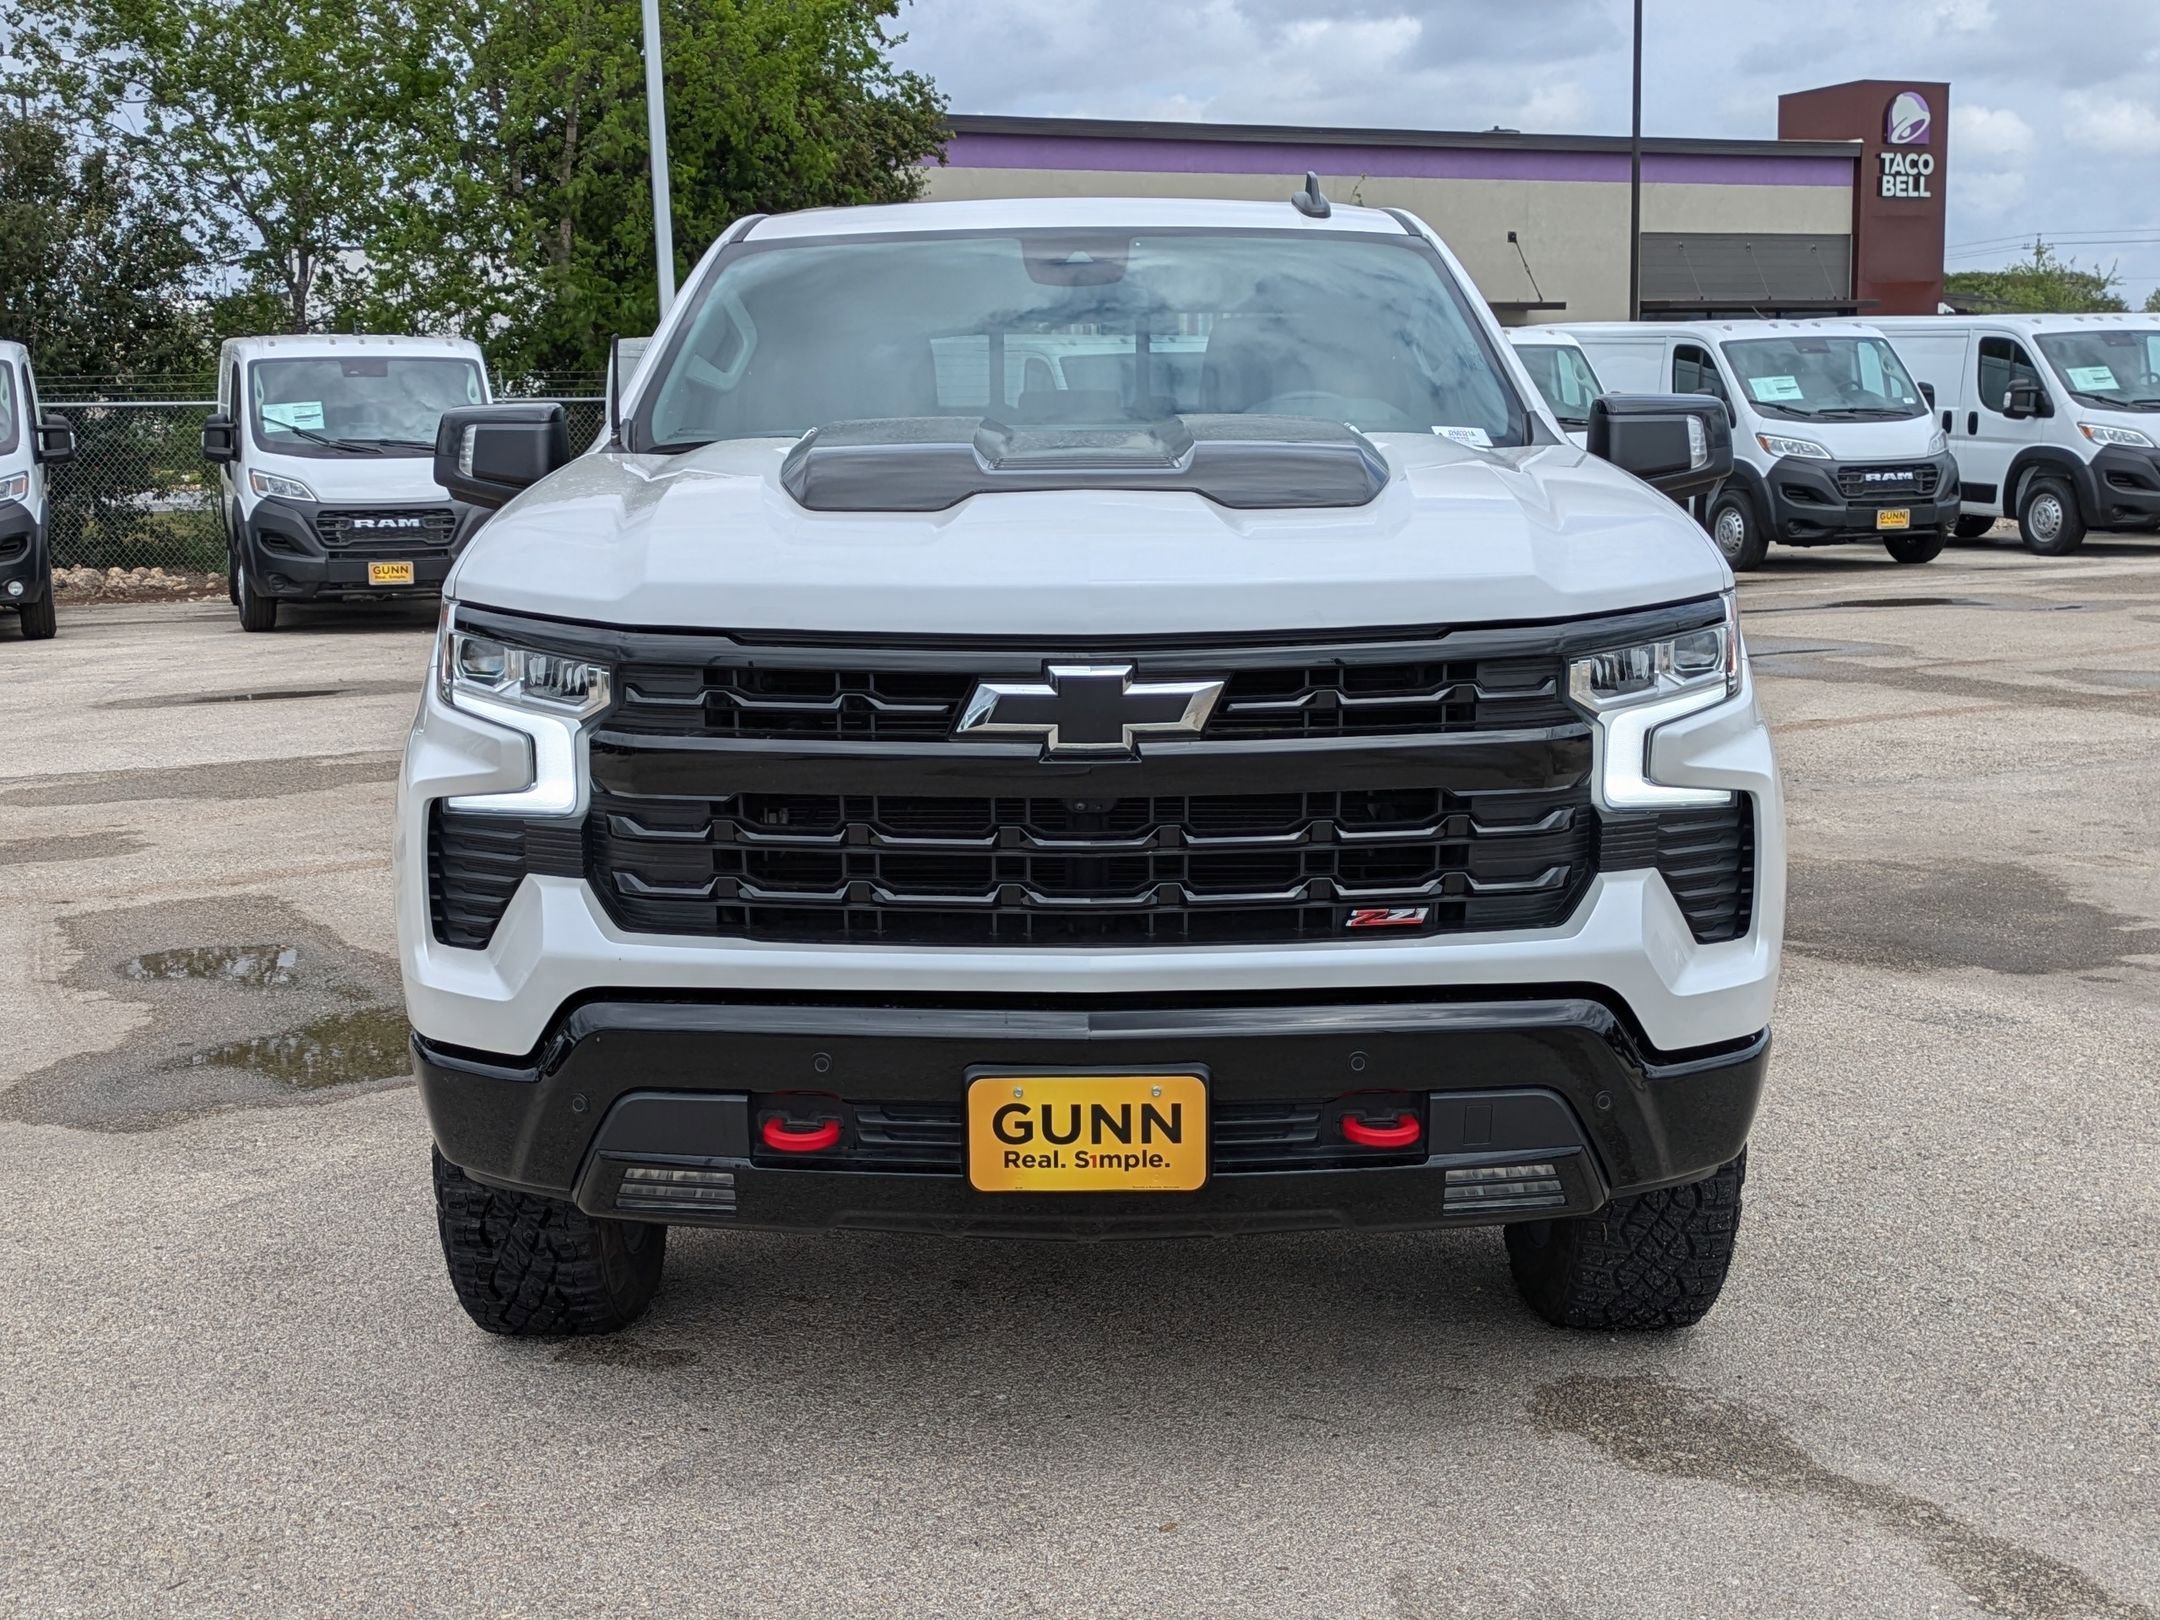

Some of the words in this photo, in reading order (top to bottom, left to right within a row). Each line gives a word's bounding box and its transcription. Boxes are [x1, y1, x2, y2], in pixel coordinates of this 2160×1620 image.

[1880, 152, 1935, 175] TACO
[1881, 175, 1931, 198] BELL
[1865, 472, 1914, 481] RAM
[1880, 511, 1906, 520] GUNN
[353, 518, 420, 528] RAM
[372, 565, 409, 575] GUNN
[992, 1102, 1182, 1145] GUNN
[1003, 1150, 1067, 1169] Real.
